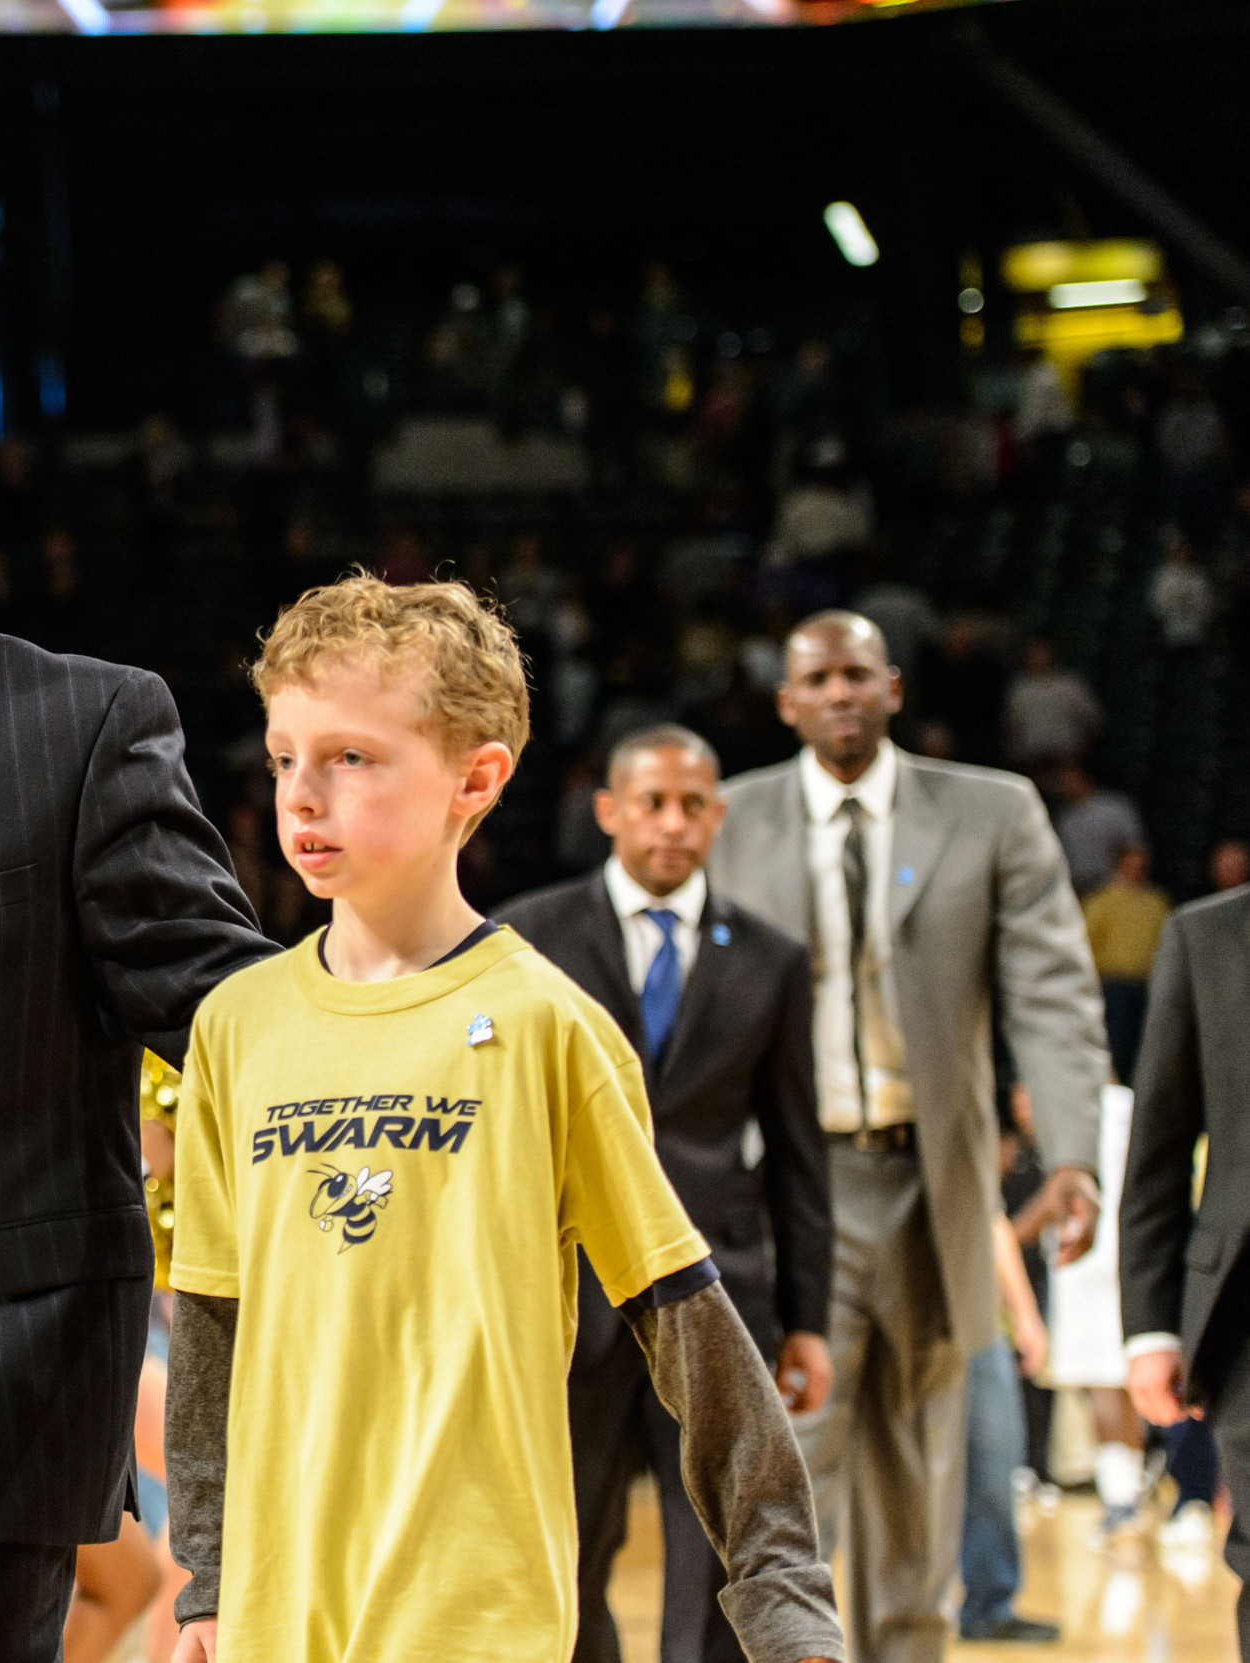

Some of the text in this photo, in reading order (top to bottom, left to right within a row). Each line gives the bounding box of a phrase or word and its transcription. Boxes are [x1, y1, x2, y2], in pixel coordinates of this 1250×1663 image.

[266, 1094, 483, 1123] TOGETHER WE
[252, 1116, 474, 1166] SWARM
